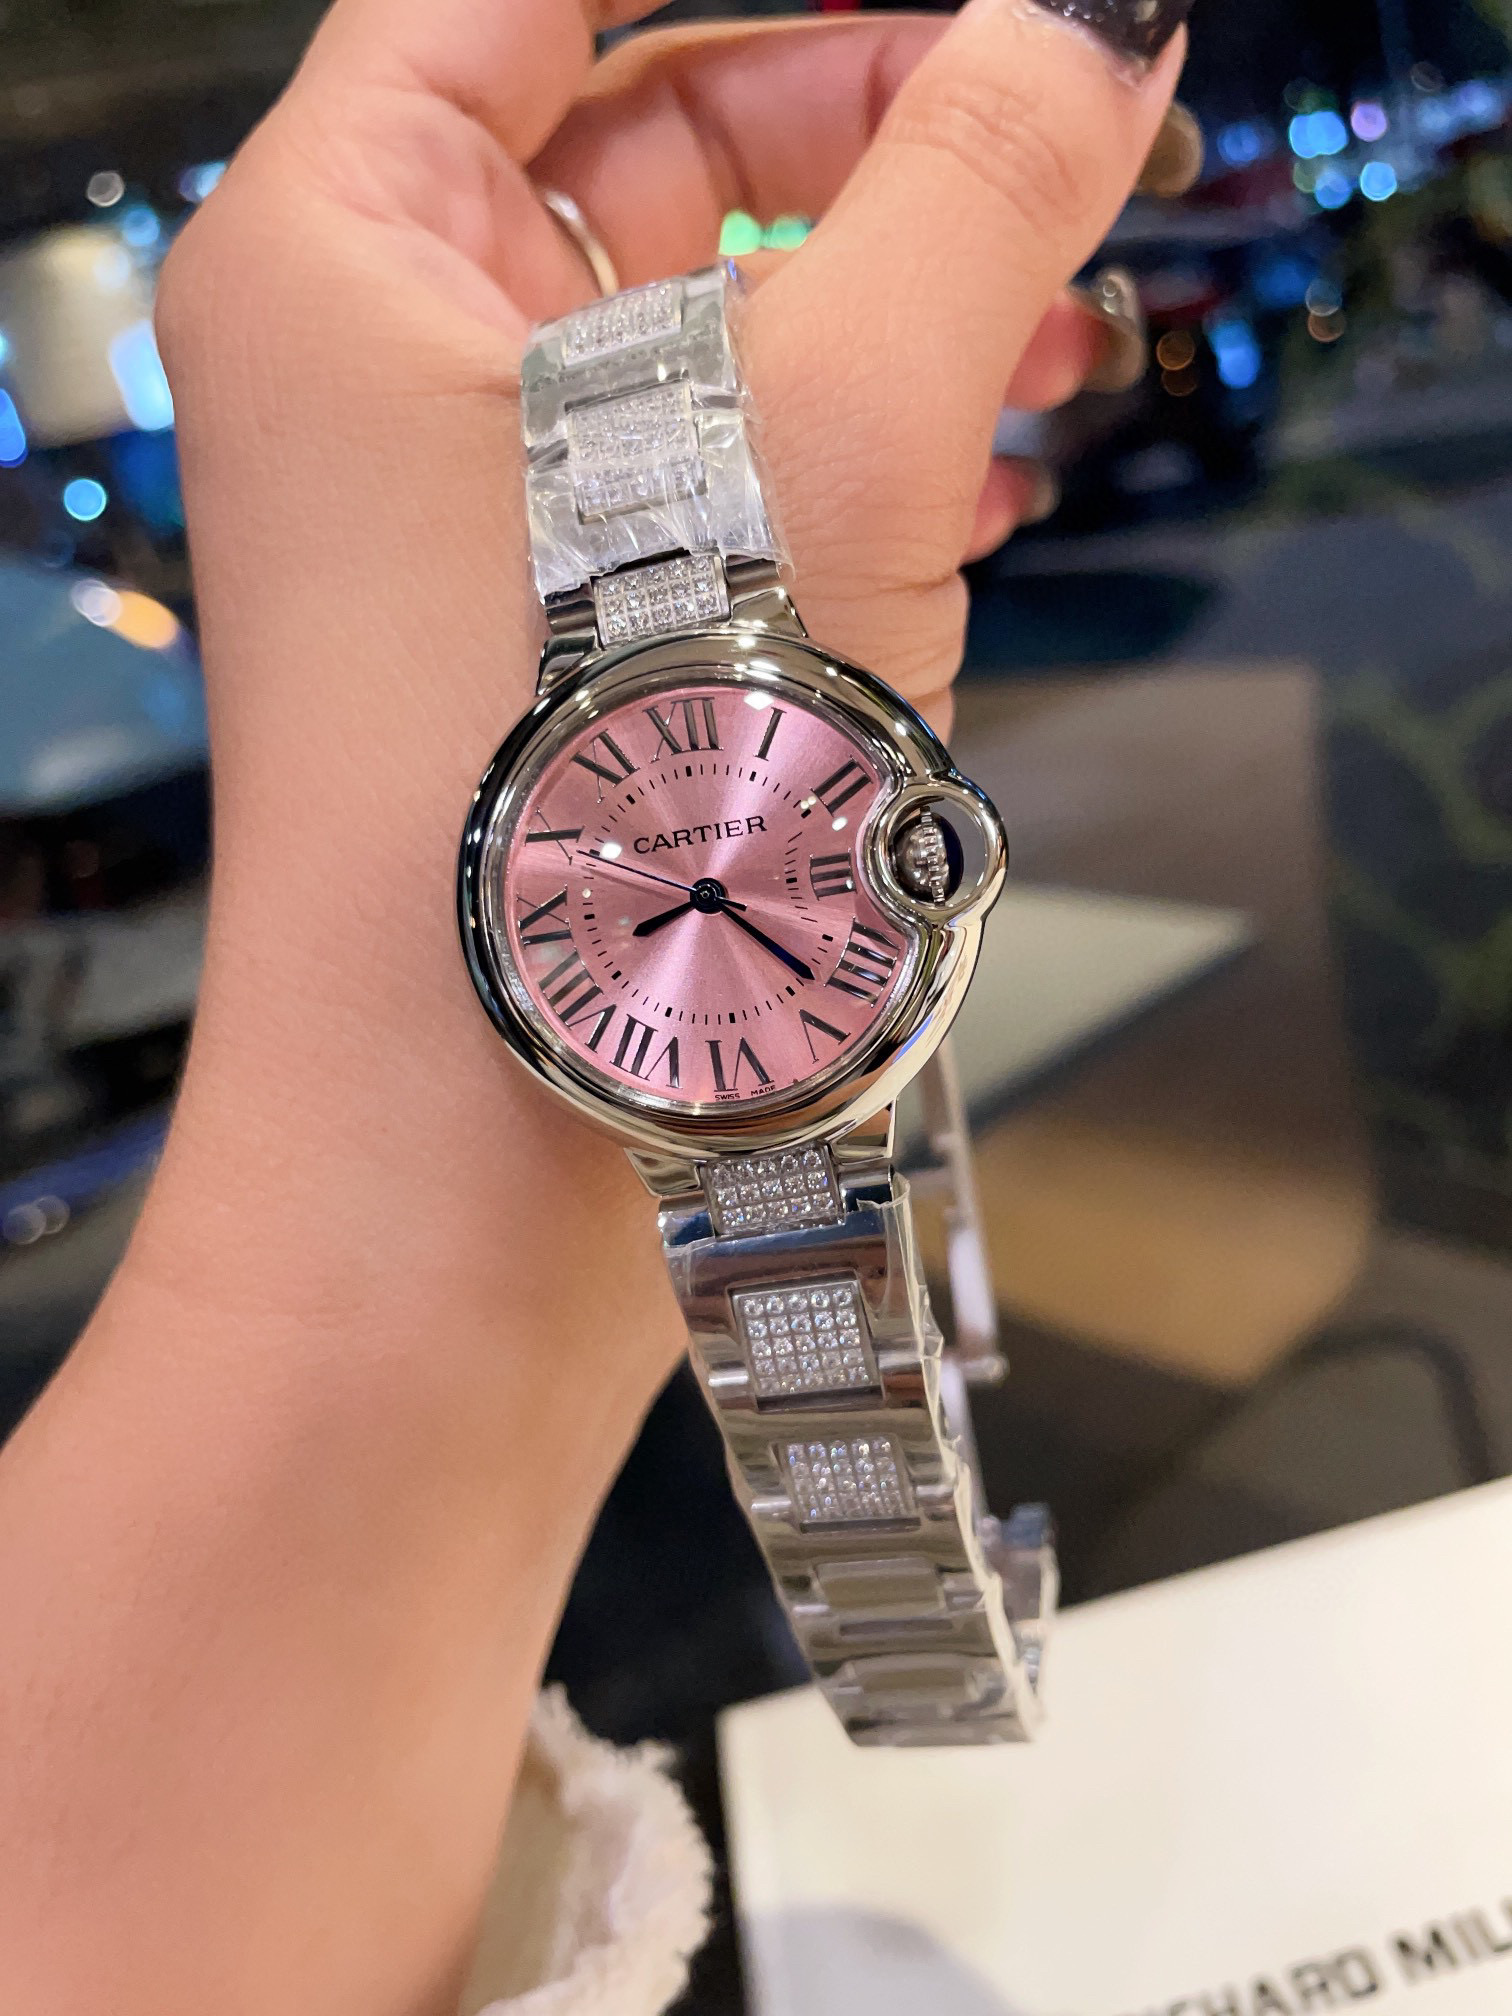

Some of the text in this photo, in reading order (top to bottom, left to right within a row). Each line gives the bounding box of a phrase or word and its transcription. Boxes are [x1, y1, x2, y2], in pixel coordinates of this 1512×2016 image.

[642, 697, 724, 765] XII
[753, 706, 787, 762] I
[569, 728, 641, 804] XI
[809, 755, 873, 817] II
[633, 815, 768, 855] CARTIER
[809, 848, 858, 901] III
[516, 884, 575, 950] IX
[535, 946, 618, 1055] VIII
[608, 1013, 684, 1091] VII
[704, 1036, 775, 1092] VI
[798, 1008, 852, 1065] V
[714, 1093, 741, 1101] SWISS
